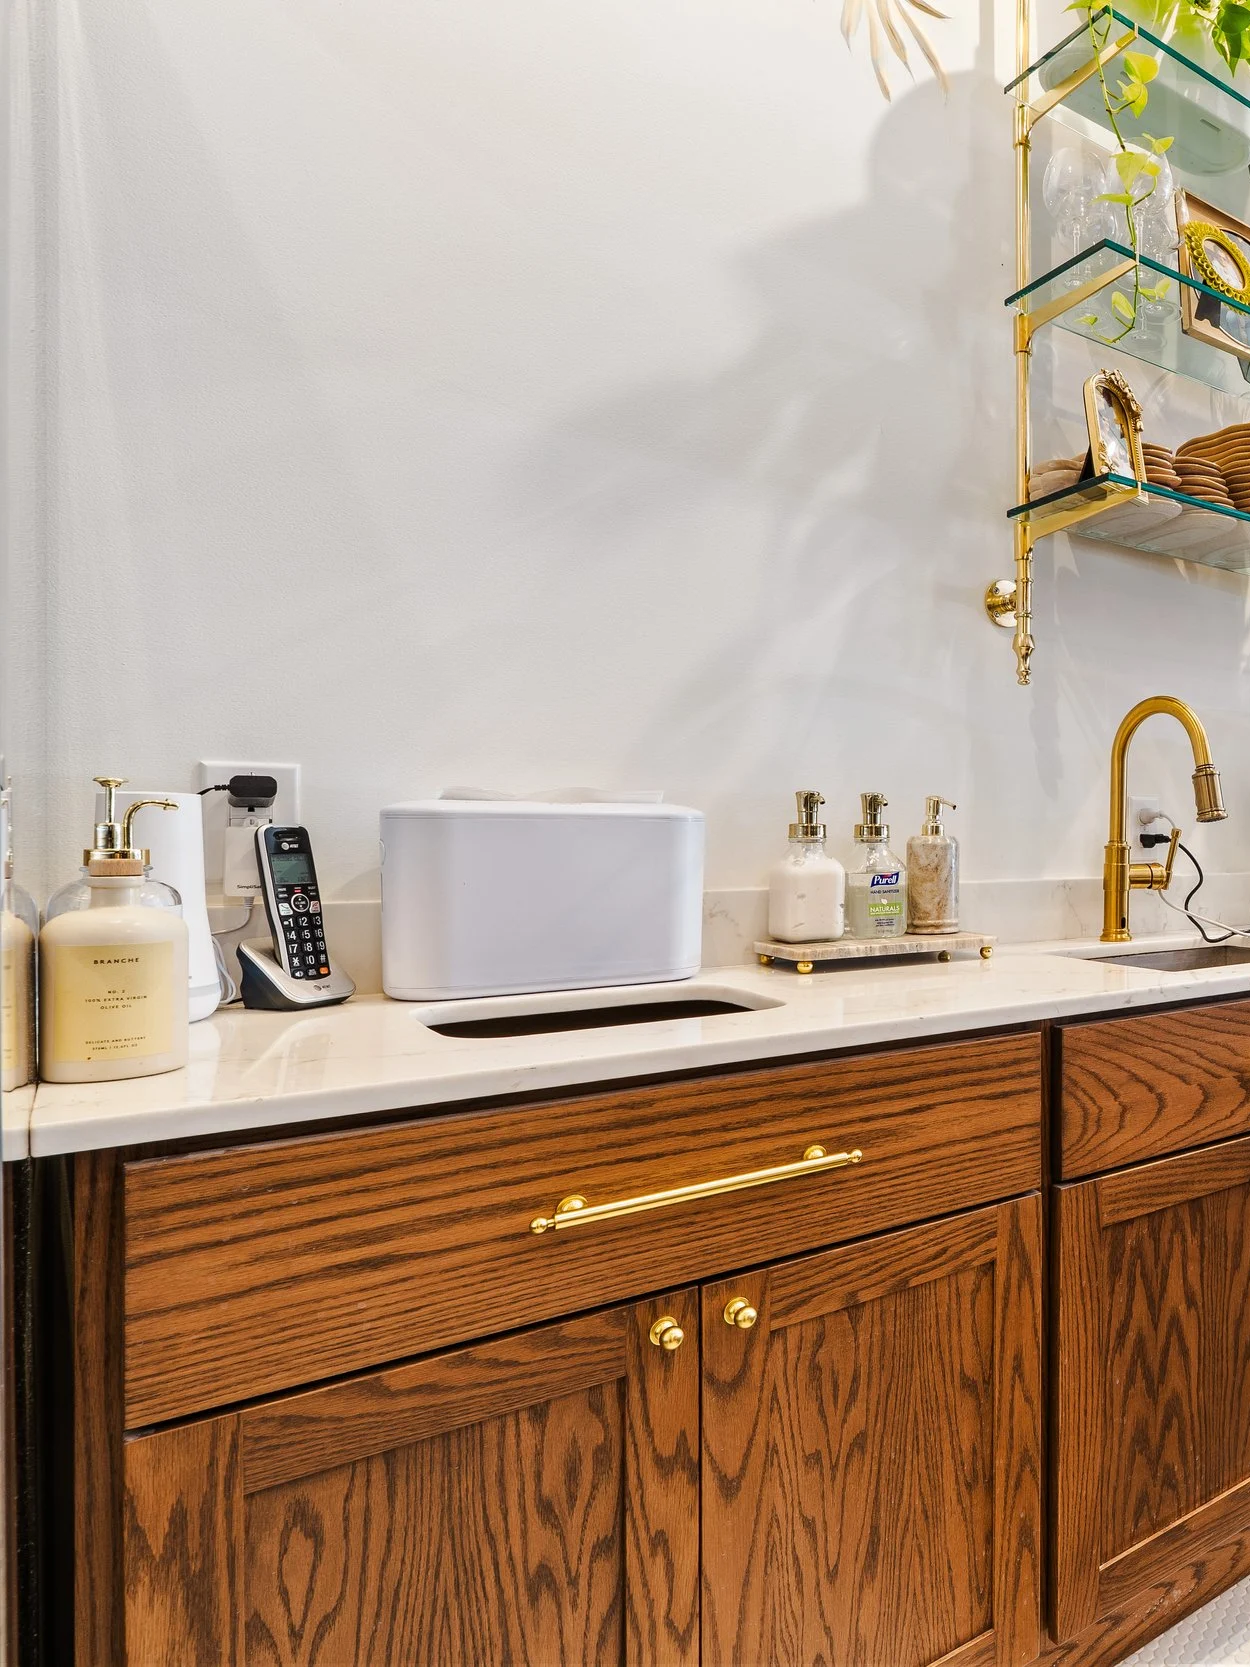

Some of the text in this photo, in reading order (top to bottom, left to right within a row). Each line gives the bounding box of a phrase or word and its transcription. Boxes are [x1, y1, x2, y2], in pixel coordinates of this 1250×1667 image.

[874, 876, 897, 885] Purell
[288, 916, 321, 927] 1 2 3
[290, 929, 323, 940] 4 5 6
[291, 941, 325, 953] 7 8 9
[309, 955, 314, 964] 0
